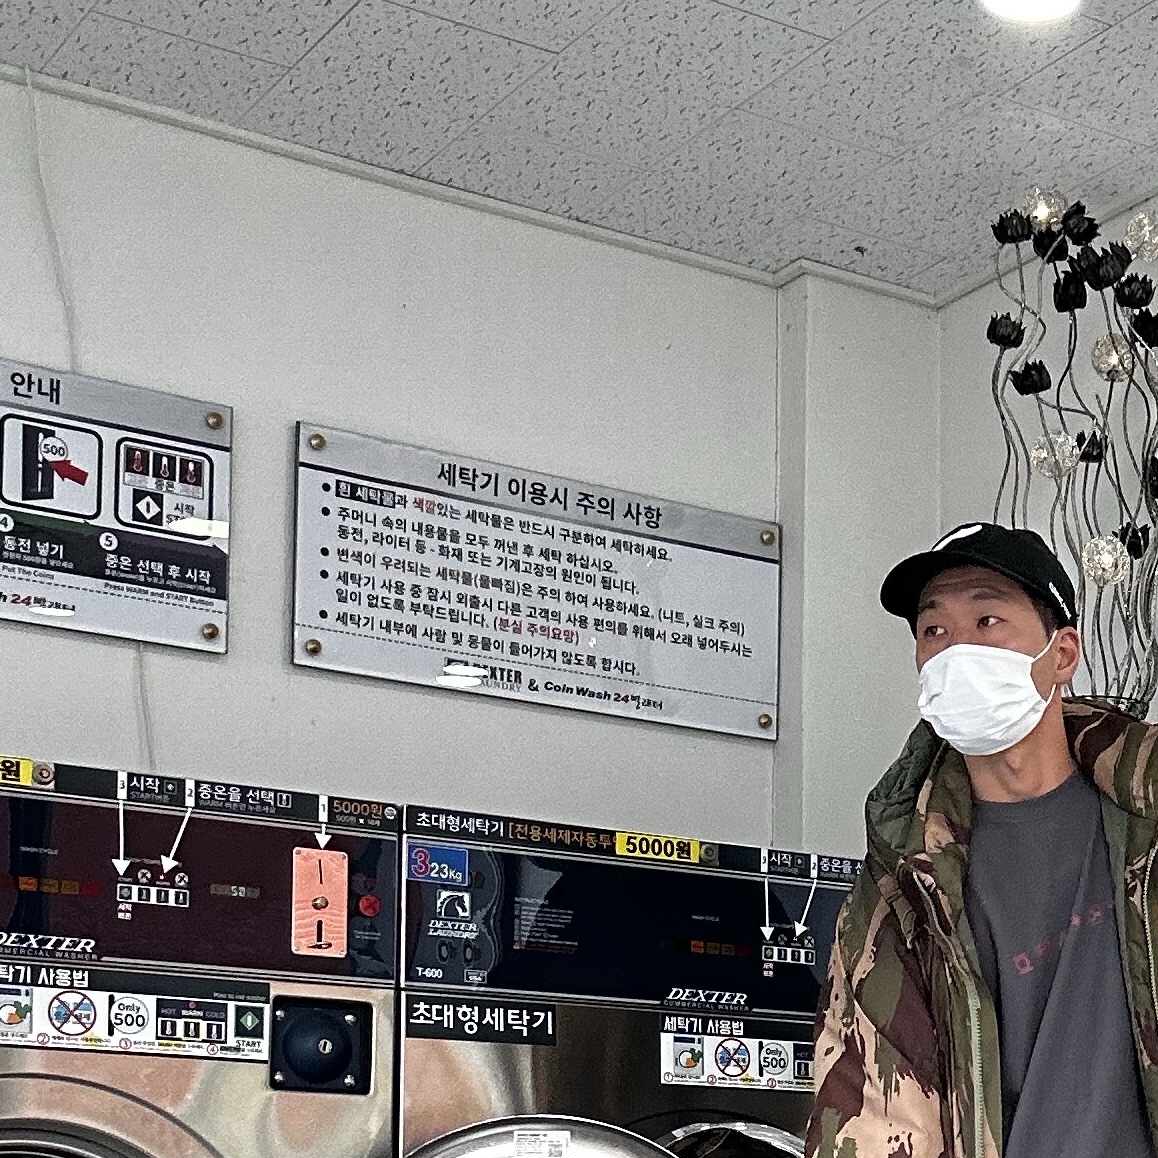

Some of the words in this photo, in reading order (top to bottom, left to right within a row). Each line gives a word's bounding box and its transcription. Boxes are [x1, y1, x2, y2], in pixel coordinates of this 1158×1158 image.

[10, 371, 60, 405] 안내
[43, 443, 65, 457] 500
[437, 462, 500, 497] 세탁기
[507, 478, 569, 511] 이용시
[576, 491, 615, 521] 주의
[623, 502, 662, 529] 사항
[337, 506, 377, 527] 주머니
[382, 515, 407, 533] 속의
[411, 517, 461, 544] 내용물을
[465, 533, 490, 550] 모두
[494, 537, 518, 556] 꺼낸
[522, 543, 534, 558] 후
[539, 544, 562, 564] 세탁
[518, 520, 555, 539] 반드시
[3, 535, 31, 553] 동전
[372, 532, 411, 551] 라이터
[415, 539, 427, 554] 등
[438, 542, 463, 562] 화재
[467, 549, 492, 567] 또는
[496, 556, 558, 580] 기계고장의
[561, 568, 597, 587] 원인이
[137, 560, 164, 577] 선택
[168, 564, 181, 579] 후
[185, 568, 211, 585] 시작
[335, 588, 362, 606] 일이
[366, 594, 405, 614] 없도록
[380, 556, 431, 578] 우려되는
[536, 586, 561, 602] 주의
[565, 590, 588, 608] 하여
[693, 614, 715, 630] 실크
[336, 570, 376, 590] 세탁기
[380, 578, 406, 596] 사용
[409, 584, 422, 599] 중
[426, 586, 451, 604] 잠시
[456, 592, 493, 612] 외출시
[497, 600, 522, 617] 다른
[525, 605, 561, 624] 고객의
[565, 613, 589, 629] 사용
[593, 617, 629, 636] 편의를
[632, 624, 667, 644] 위해서
[670, 632, 693, 648] 오래
[335, 611, 375, 631] 세탁기
[379, 619, 418, 639] 내부에
[422, 627, 447, 644] 사람
[451, 631, 463, 647] 및
[468, 634, 505, 654] 동물이
[509, 641, 557, 663] 들어가지
[561, 650, 597, 670] 않도록
[543, 681, 574, 694] Coin
[576, 686, 611, 701] Wash
[130, 776, 161, 795] 시작
[198, 783, 242, 803] 중온을
[246, 787, 275, 807] 선택
[332, 799, 383, 819] 5000원
[415, 812, 504, 837] 초대형세탁기
[626, 836, 692, 860] 5000원
[412, 849, 431, 877] 3
[769, 853, 793, 866] 시작
[37, 967, 89, 988] 사용법
[666, 987, 748, 1005] DEXTER
[117, 1003, 141, 1014] Only
[409, 1001, 553, 1037] 초대형세탁기
[114, 1014, 146, 1028] 500
[663, 1015, 702, 1034] 세탁기
[706, 1019, 744, 1036] 사용법
[235, 1039, 262, 1048] START
[762, 1057, 787, 1069] 500
